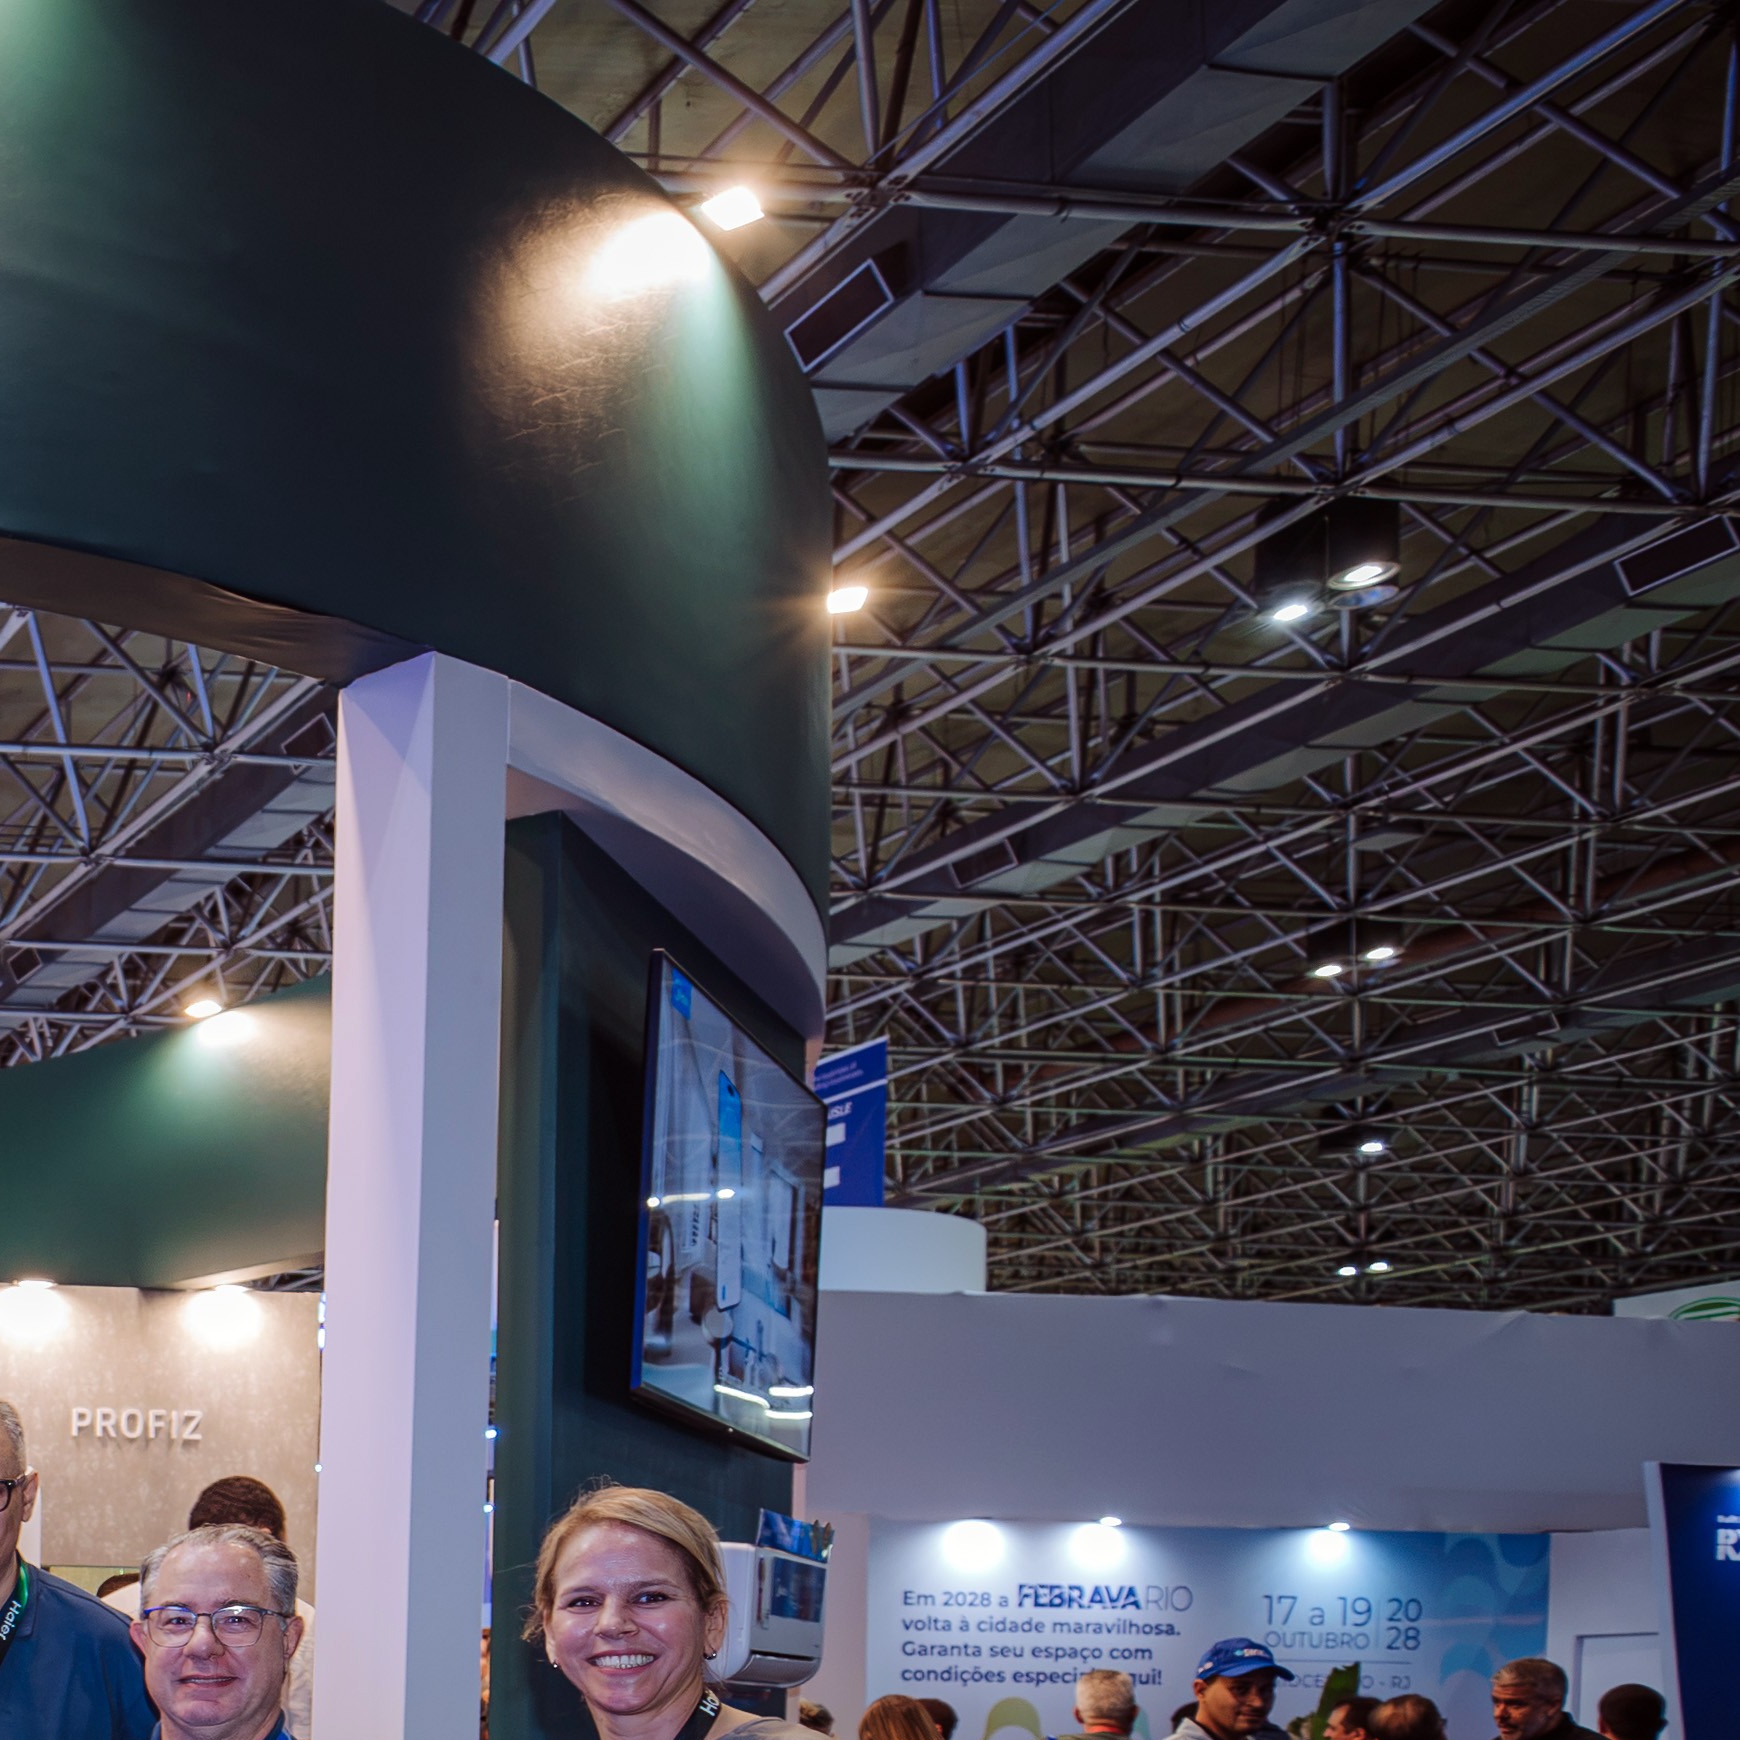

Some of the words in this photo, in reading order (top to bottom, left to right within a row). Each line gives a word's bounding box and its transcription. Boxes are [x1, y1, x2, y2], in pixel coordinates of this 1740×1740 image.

[71, 1407, 204, 1440] PROFIZ
[902, 1590, 935, 1606] Em
[942, 1591, 991, 1606] 2028
[999, 1595, 1008, 1606] a
[1263, 1594, 1298, 1625] 17
[1309, 1606, 1325, 1627] a
[1337, 1597, 1372, 1627] 19
[1386, 1598, 1422, 1622] 20
[902, 1616, 951, 1632] volta
[959, 1616, 969, 1632] à
[977, 1617, 1045, 1633] cidade
[1052, 1617, 1181, 1636] maravilhosa.
[1264, 1631, 1369, 1650] OUTUBRO
[1386, 1627, 1421, 1651] 28
[902, 1641, 981, 1657] Garanta
[989, 1646, 1023, 1658] seu
[1031, 1647, 1102, 1663] espaço
[1110, 1648, 1153, 1660] com
[901, 1666, 1005, 1686] condições
[1013, 1667, 1084, 1687] especi
